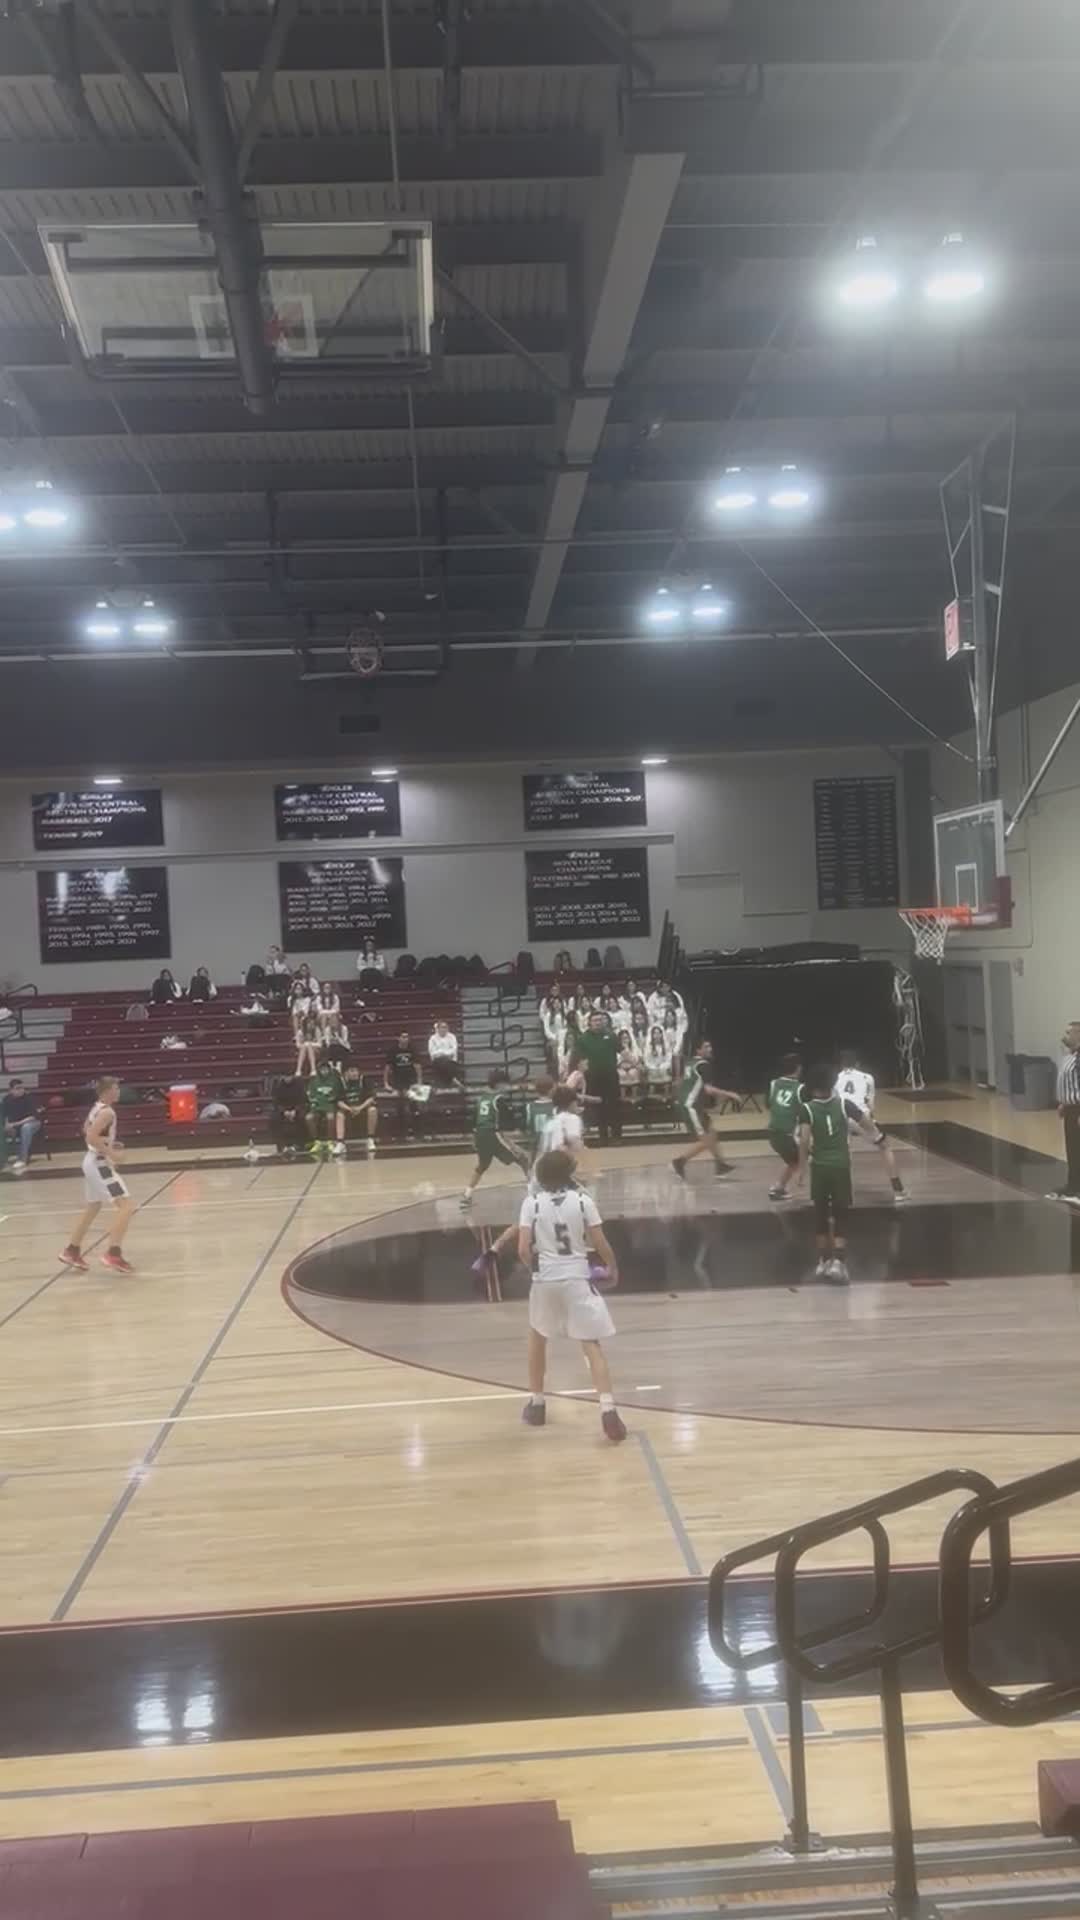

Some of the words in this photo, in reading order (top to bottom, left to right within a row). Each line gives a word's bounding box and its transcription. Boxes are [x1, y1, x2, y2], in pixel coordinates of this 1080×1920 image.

[844, 1080, 855, 1094] 4
[480, 1101, 489, 1115] 5
[826, 1115, 833, 1136] 1
[554, 1223, 572, 1255] 5
